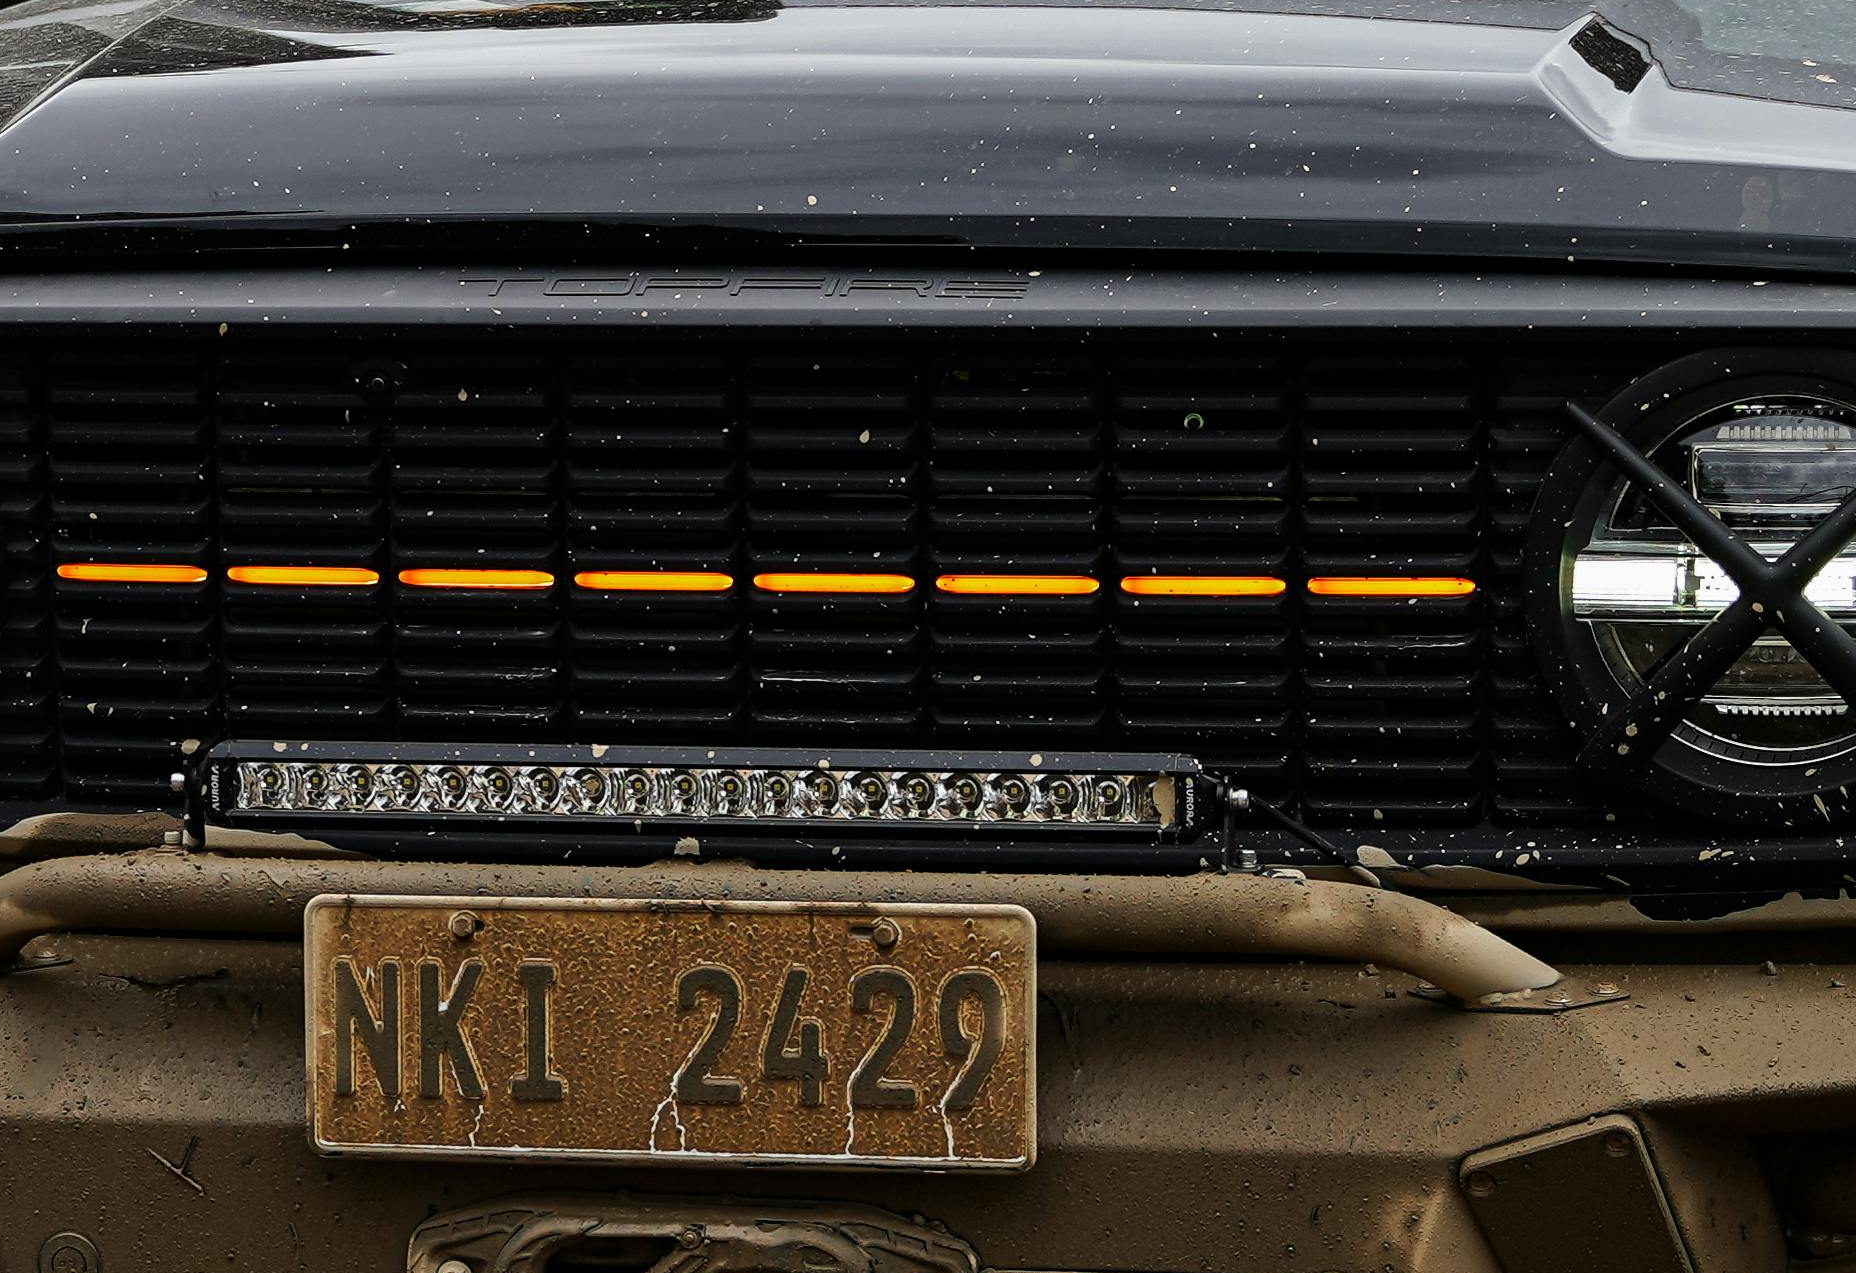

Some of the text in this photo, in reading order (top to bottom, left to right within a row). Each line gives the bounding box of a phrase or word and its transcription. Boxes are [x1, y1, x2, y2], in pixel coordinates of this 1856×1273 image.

[457, 275, 1031, 300] TOPFIRE
[210, 762, 220, 812] AURORA
[1185, 777, 1194, 827] AURORA
[332, 955, 1009, 1111] NKI 2429
